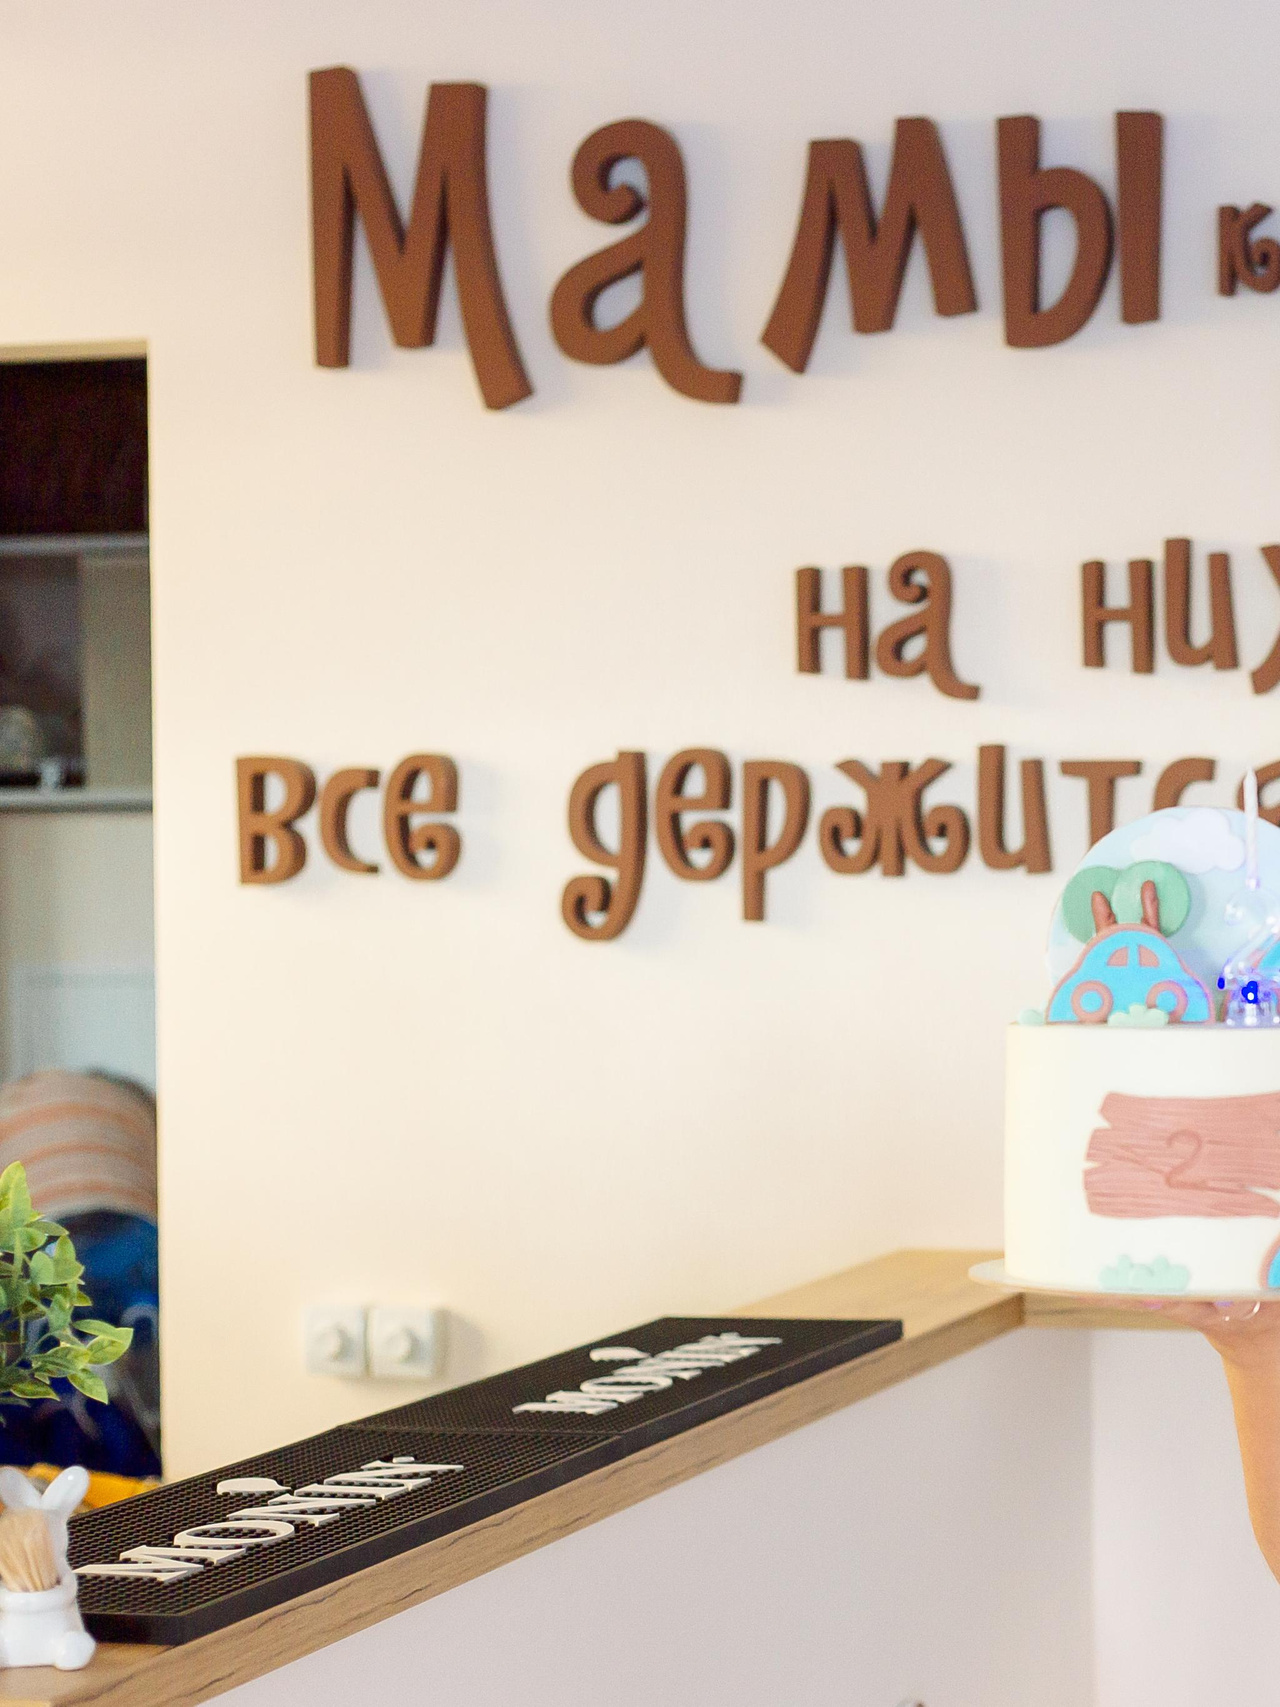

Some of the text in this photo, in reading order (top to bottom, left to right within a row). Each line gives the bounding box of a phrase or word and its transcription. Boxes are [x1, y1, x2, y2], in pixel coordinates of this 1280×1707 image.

[308, 66, 1164, 411] Мамы
[795, 551, 981, 700] на
[235, 751, 462, 886] все
[1165, 1129, 1209, 1189] 2
[72, 1457, 464, 1582] MONIN
